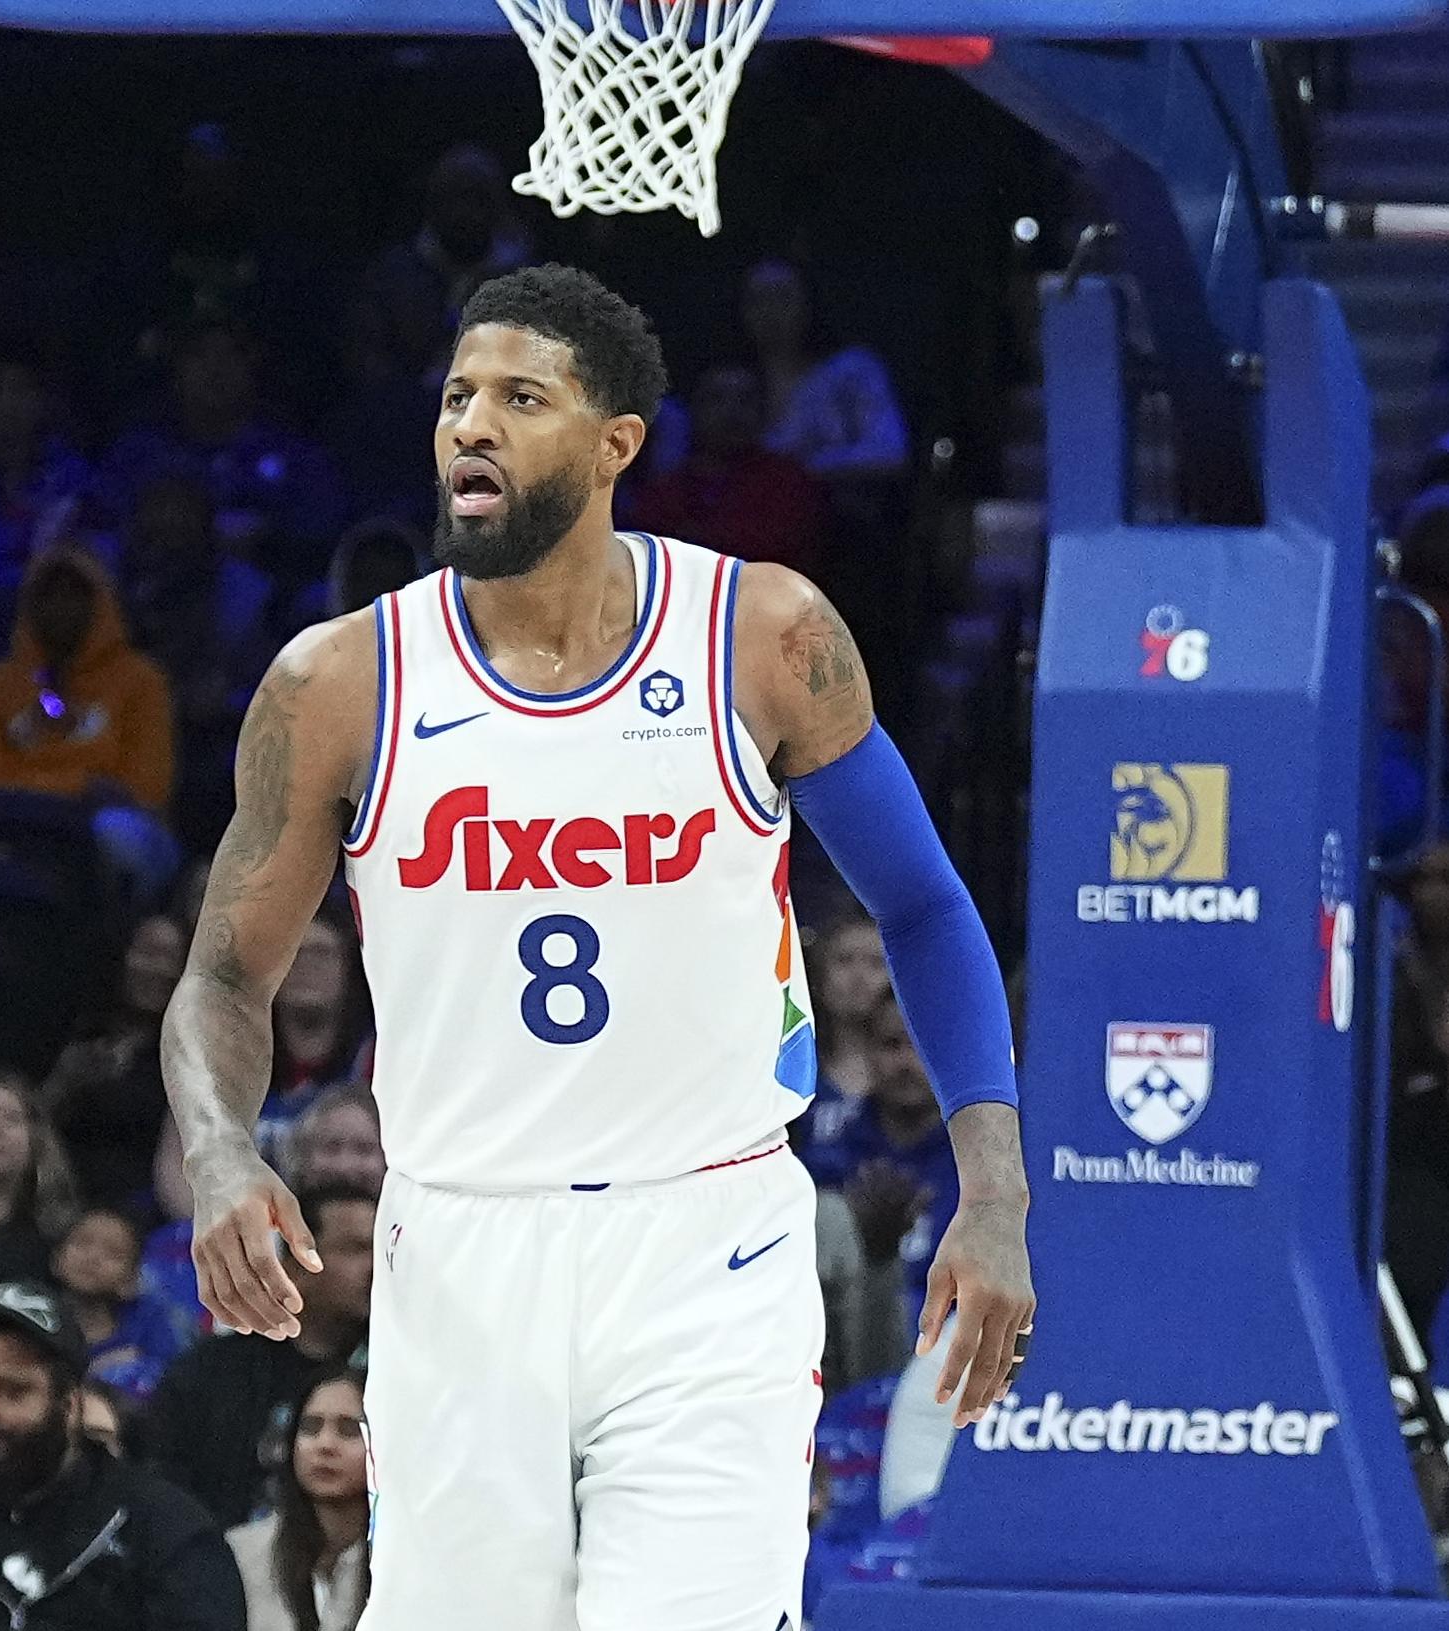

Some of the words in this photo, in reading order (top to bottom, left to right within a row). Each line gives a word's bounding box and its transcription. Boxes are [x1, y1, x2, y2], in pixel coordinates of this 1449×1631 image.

[1139, 628, 1211, 682] 76
[622, 726, 707, 741] crypto.com
[397, 786, 716, 892] Sixers
[1077, 885, 1259, 923] BETMGM
[517, 914, 610, 1045] 8
[1052, 1145, 1124, 1183] Penn
[1124, 1147, 1261, 1188] Medicine
[973, 1391, 1340, 1455] ticketmaster
